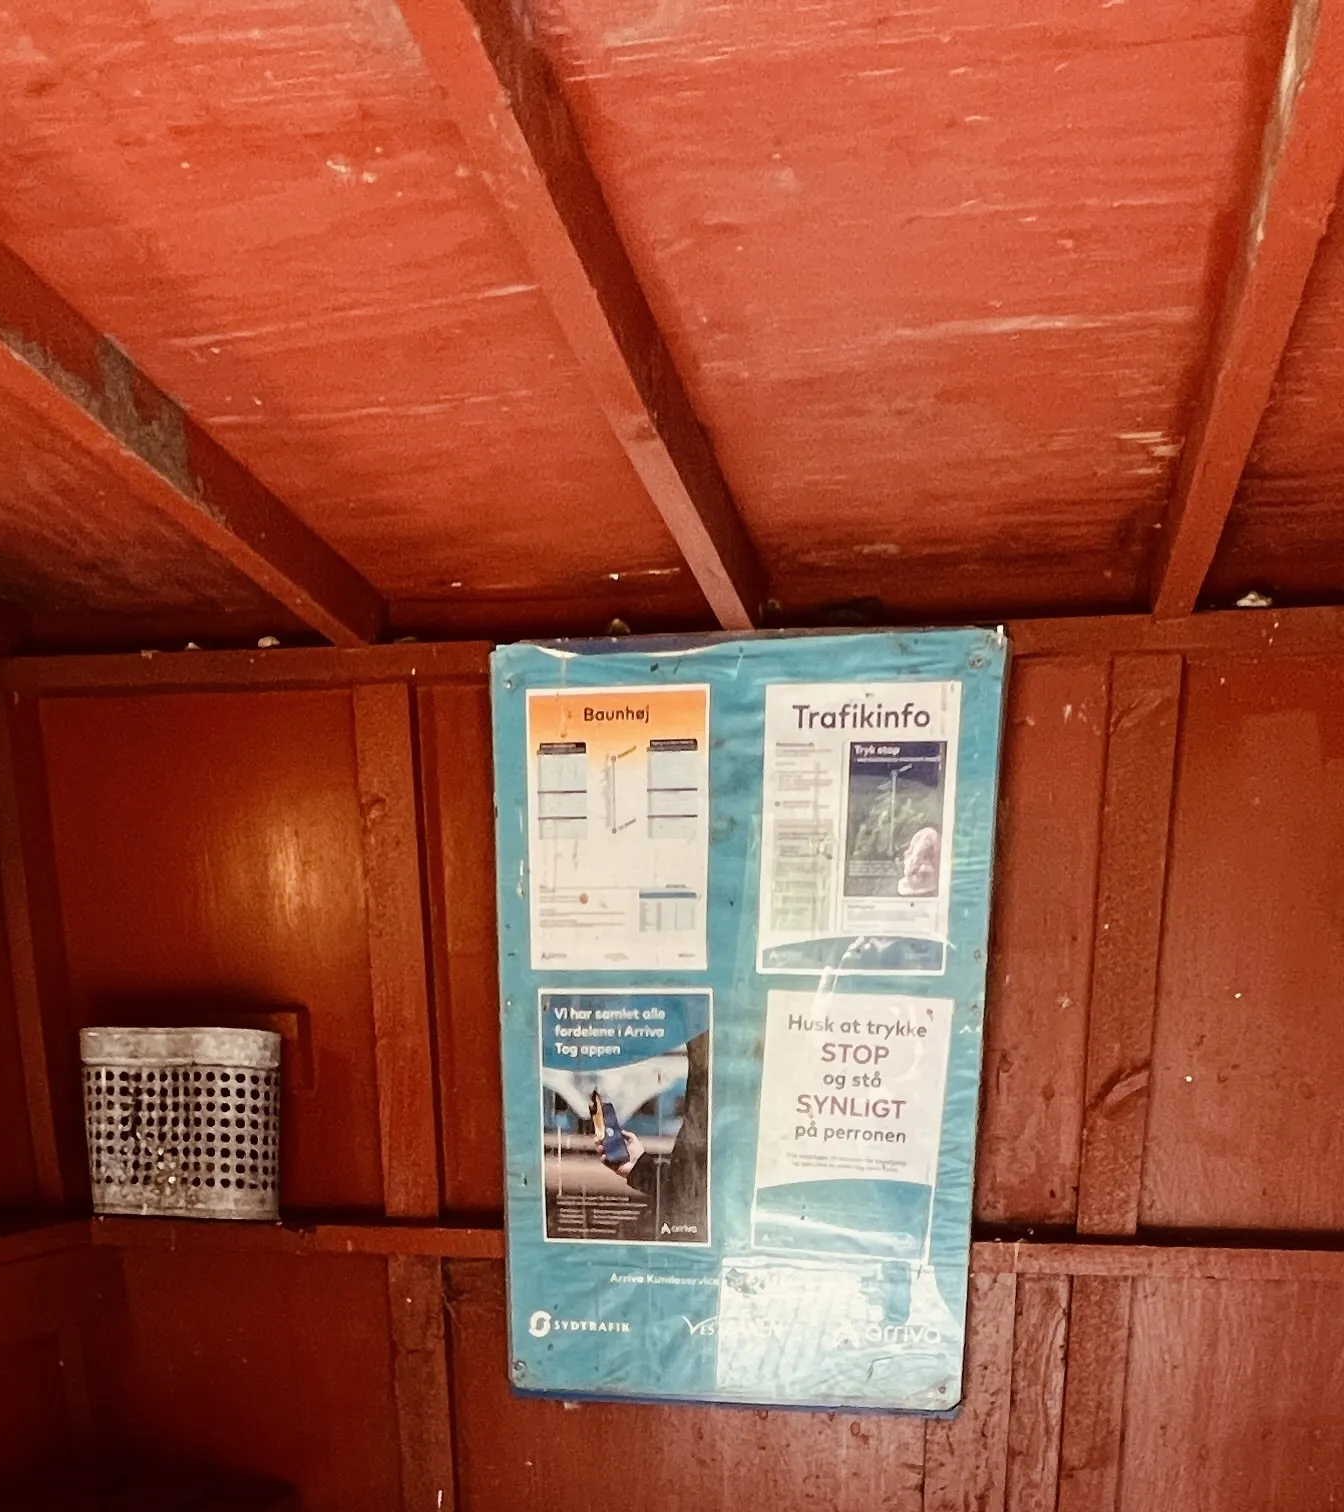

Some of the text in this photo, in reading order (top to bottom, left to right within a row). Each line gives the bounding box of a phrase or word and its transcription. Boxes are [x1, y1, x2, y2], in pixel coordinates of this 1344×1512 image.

[584, 705, 650, 723] Baunhøj
[792, 703, 931, 729] Trafikinfo
[555, 1007, 666, 1020] Vi har samlet alle
[555, 1024, 615, 1038] fordelene
[624, 1025, 665, 1038] Arriva
[788, 1014, 928, 1040] Husk at trykke
[555, 1042, 621, 1058] Tag appen
[821, 1042, 890, 1065] STOP
[823, 1070, 882, 1090] og stå
[796, 1093, 907, 1119] SYNLIGT
[795, 1120, 907, 1143] på perronen
[610, 1272, 644, 1285] Arriva
[646, 1273, 721, 1287] Kundeservice
[554, 1319, 632, 1332] SYDTRAFIK
[864, 1322, 942, 1344] arriva
